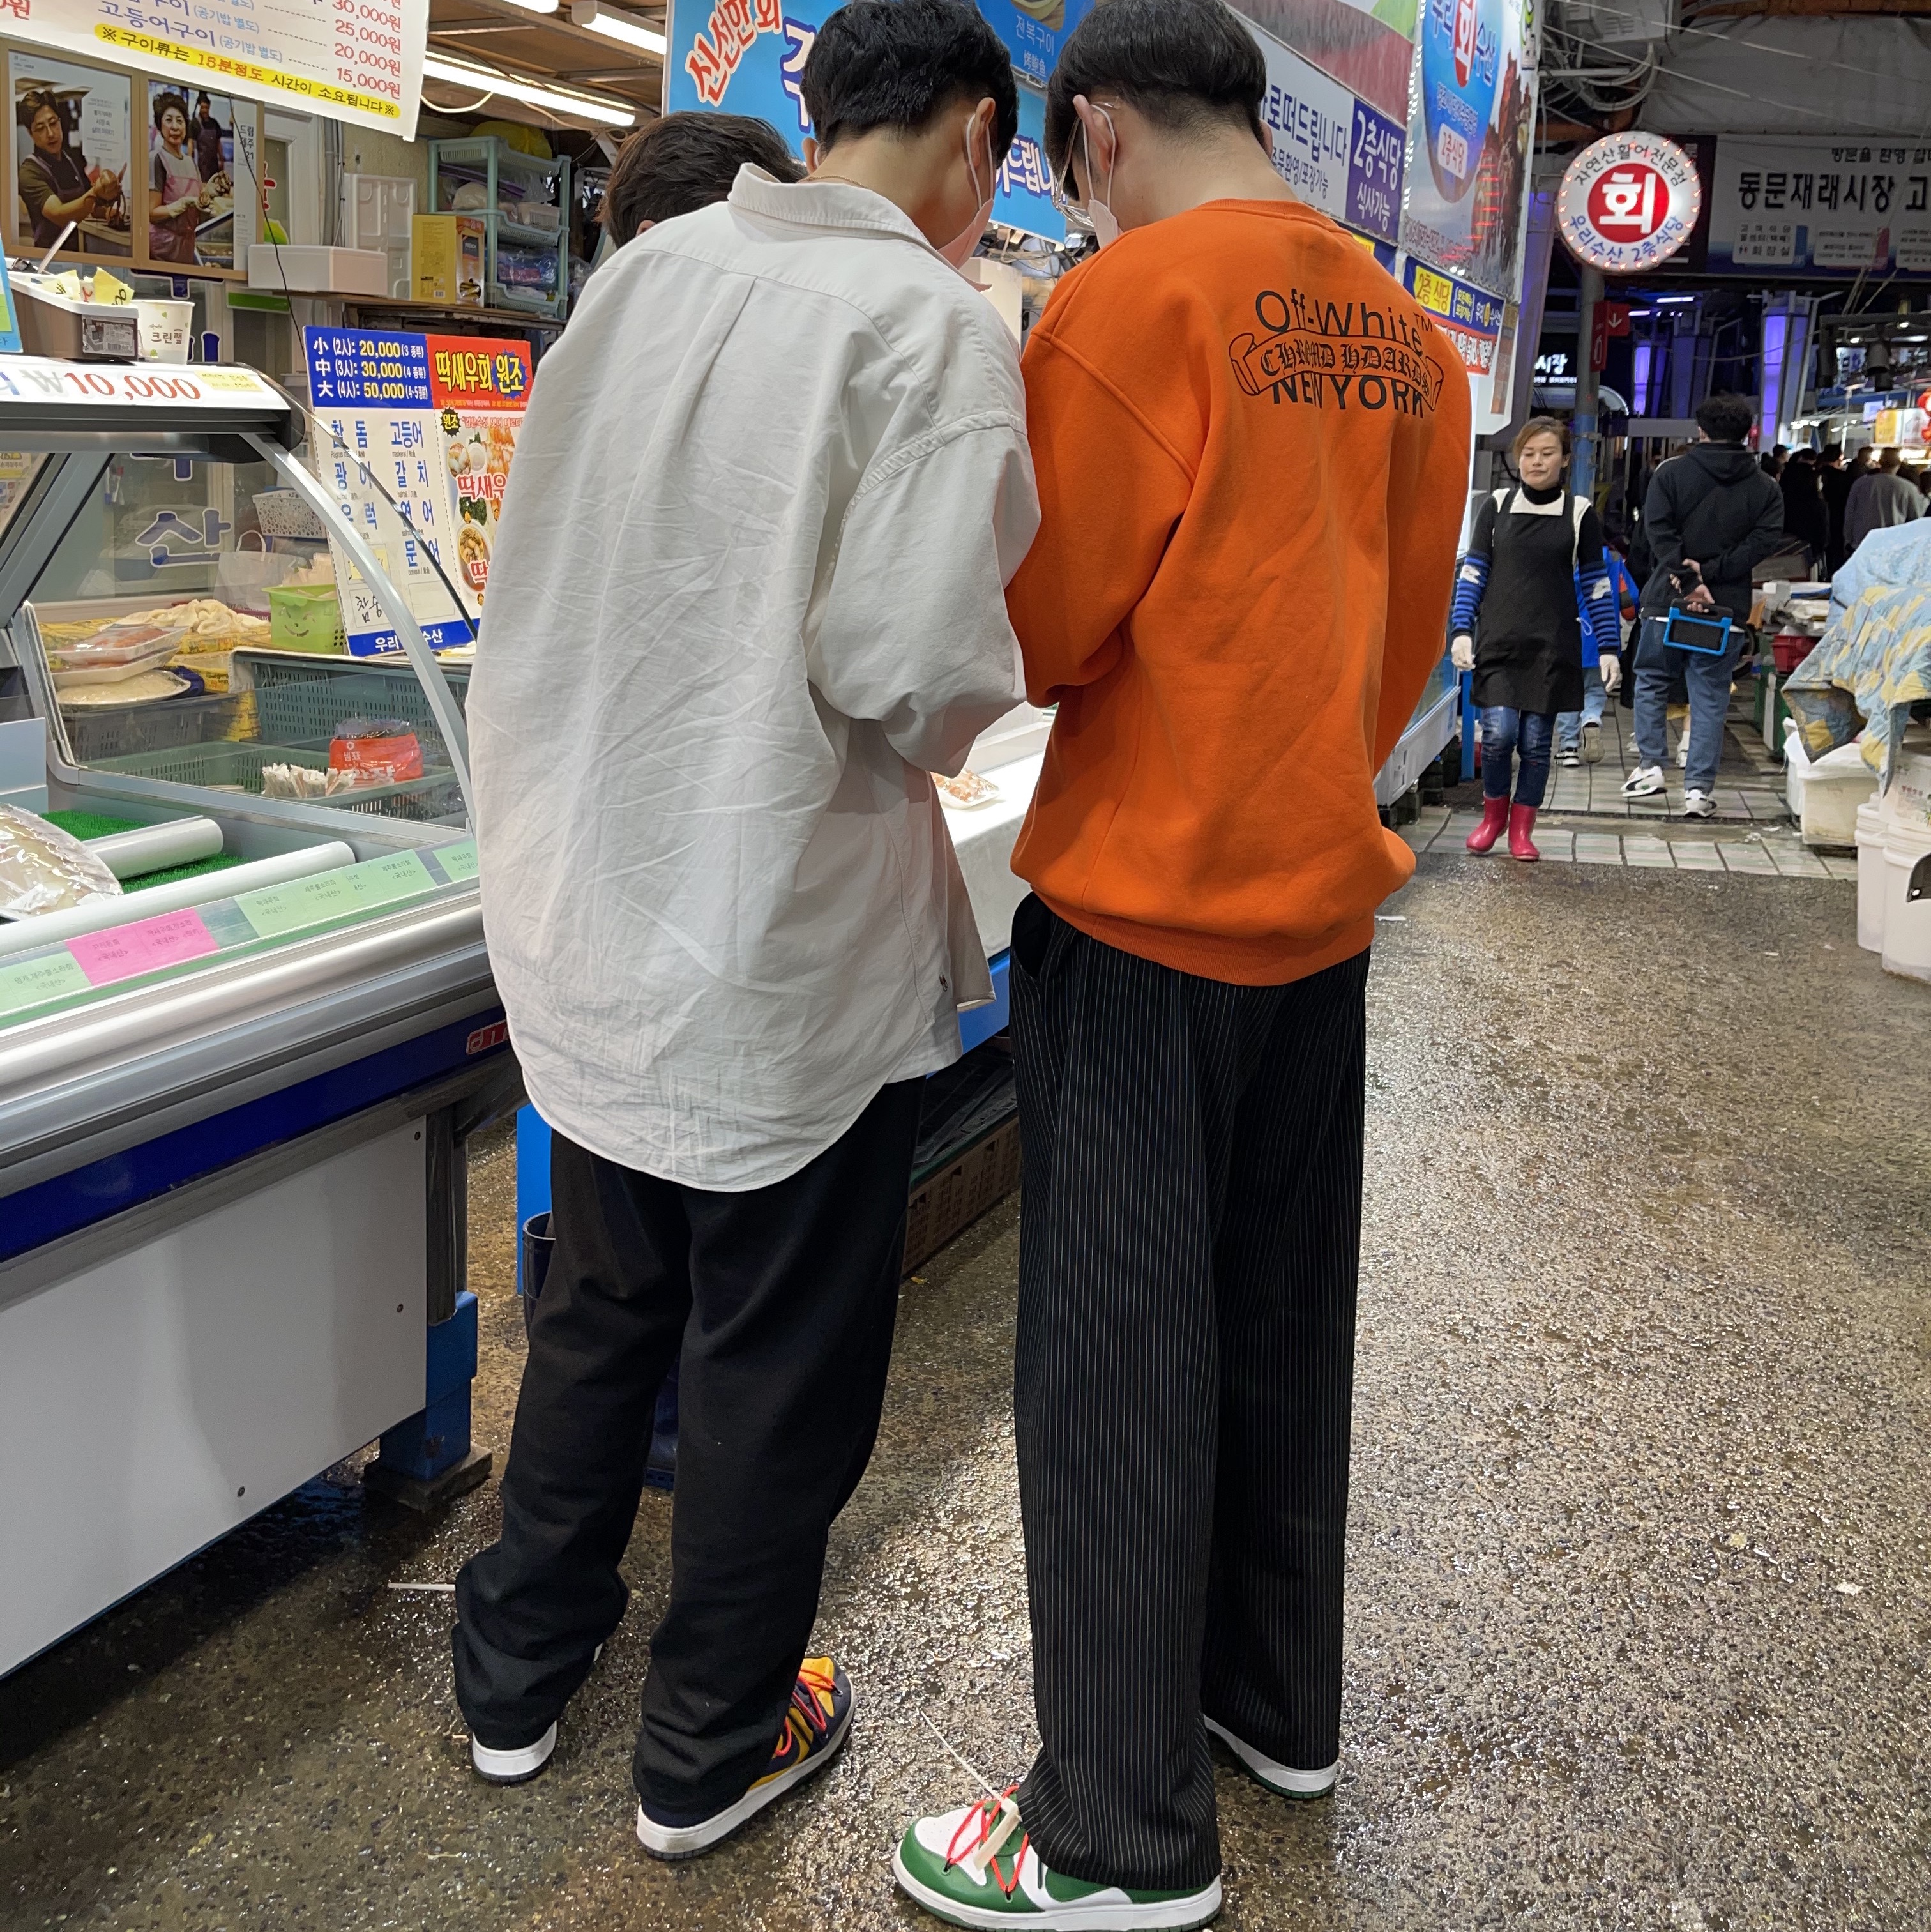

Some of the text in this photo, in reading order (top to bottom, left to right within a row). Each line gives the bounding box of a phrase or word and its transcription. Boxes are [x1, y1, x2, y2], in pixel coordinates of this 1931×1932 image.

[98, 0, 400, 100] 고등어구이 (공기밥 별도) 15,000원
[193, 3, 227, 26] (공기밥
[234, 16, 260, 33] 별도)
[334, 42, 401, 77] 20,000원
[335, 19, 401, 54] 25,000원
[1015, 15, 1054, 56] 전복구이
[197, 53, 264, 82] 15분정도
[271, 72, 312, 95] 시간이
[1353, 109, 1402, 191] 2층식당
[1574, 143, 1688, 187] 자연산활어전문점
[1357, 181, 1391, 232] 식사가능
[1599, 172, 1656, 234] 회
[1738, 172, 1895, 213] 동문재래시장
[1570, 215, 1684, 264] 우리수산 2층식당
[1416, 273, 1431, 305] 2층
[1434, 280, 1450, 312] 식당
[314, 337, 329, 355] 小
[359, 340, 402, 360] 20,000
[315, 359, 331, 377] 中
[360, 361, 404, 379] 30,000
[1534, 353, 1569, 376] 시장
[317, 380, 334, 398] 大
[363, 383, 405, 401] 50,000
[435, 350, 525, 394] 딱새우회 원조
[1273, 372, 1322, 409] NEW
[390, 420, 425, 448] 고등어
[443, 414, 459, 430] 원조
[375, 635, 399, 652] 우리
